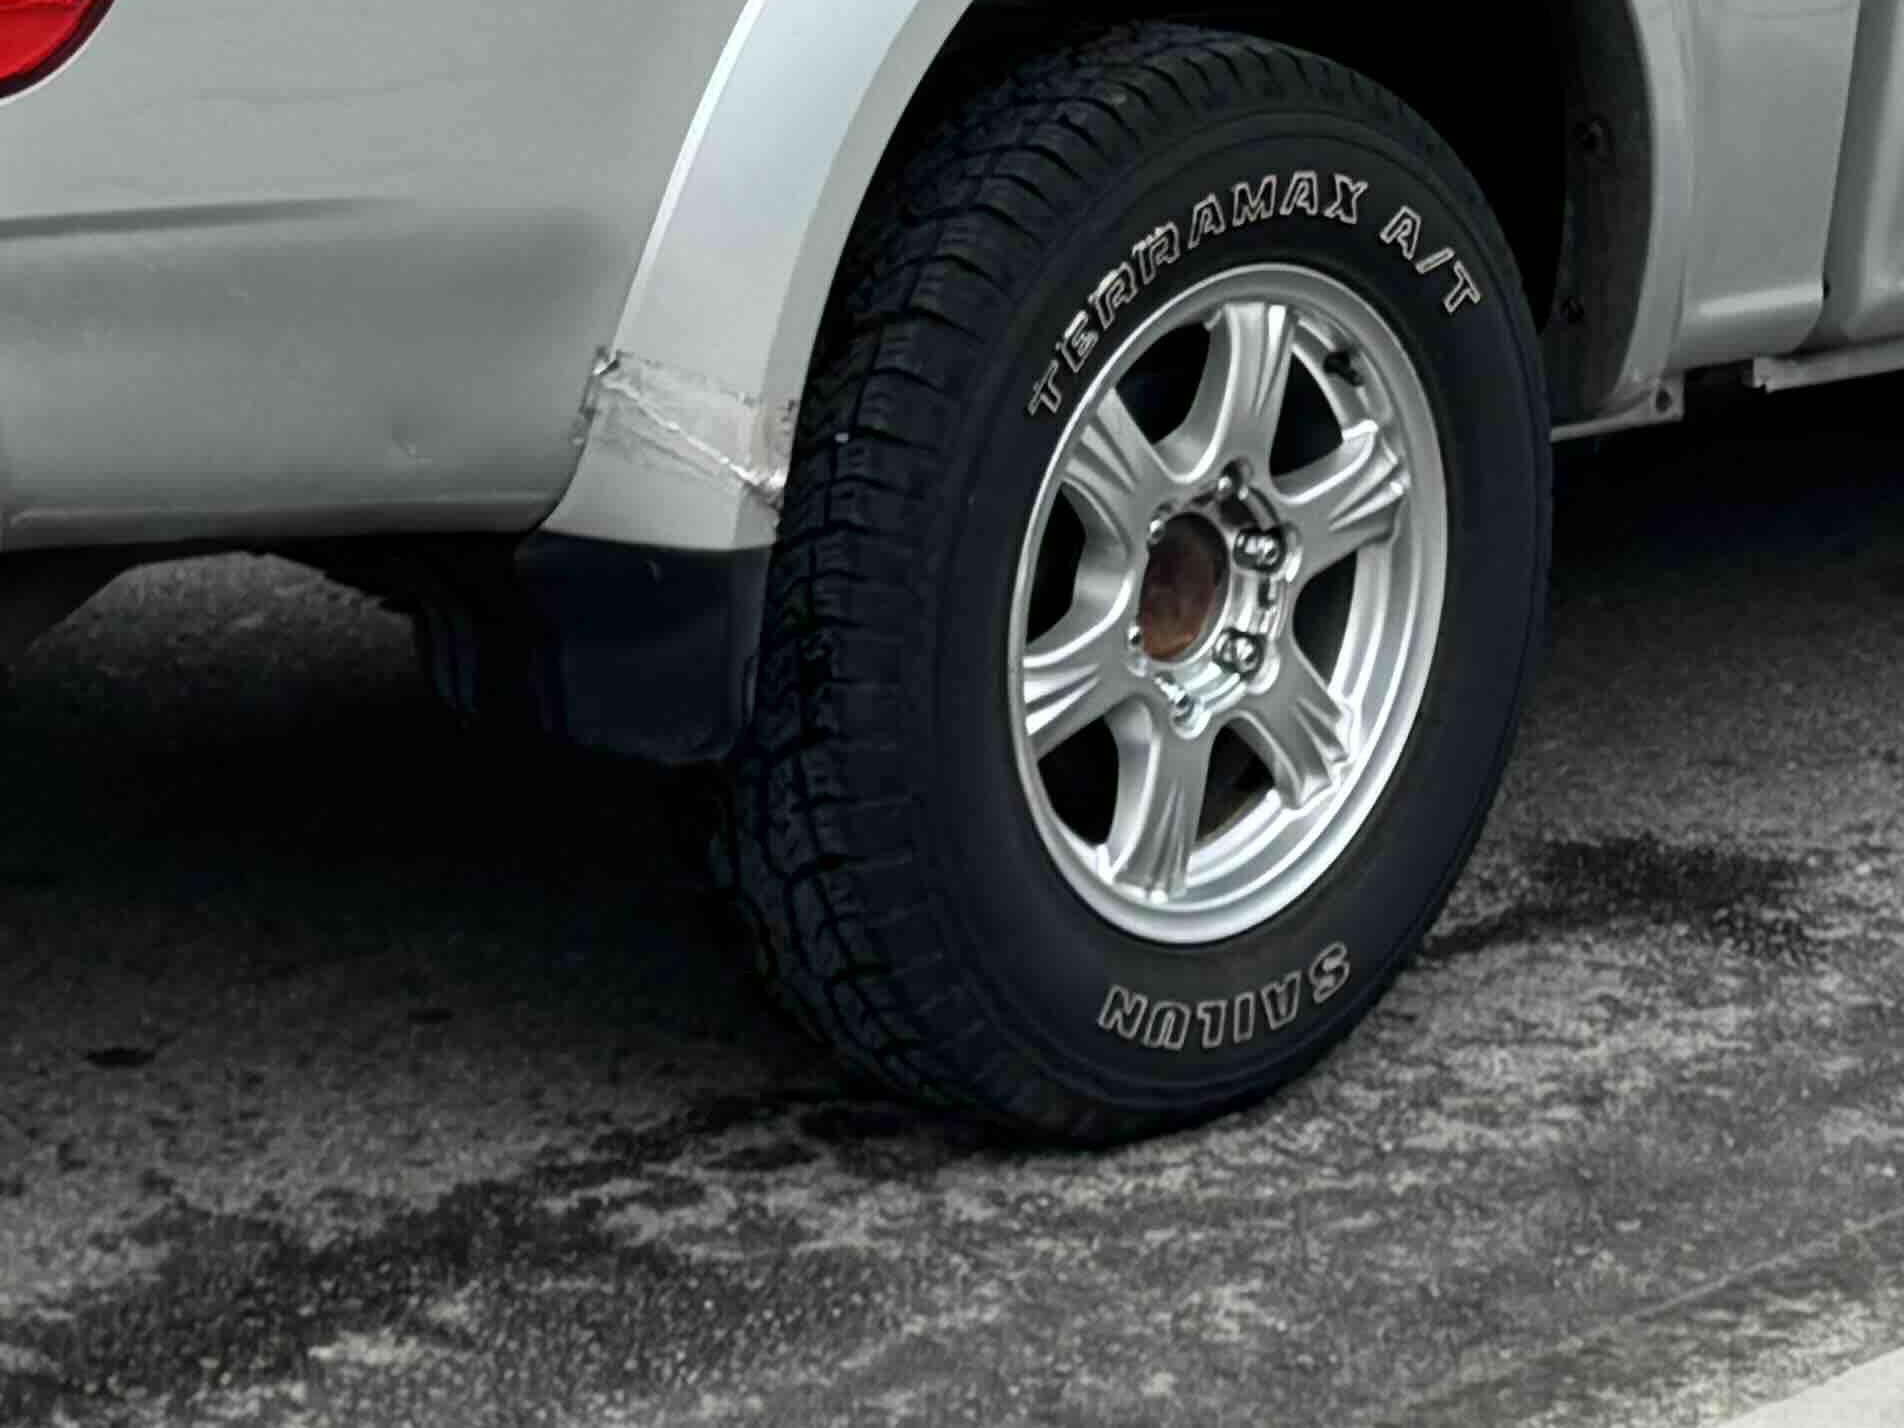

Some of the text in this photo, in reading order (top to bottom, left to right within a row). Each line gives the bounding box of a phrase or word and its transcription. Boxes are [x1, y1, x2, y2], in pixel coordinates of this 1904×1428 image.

[1027, 170, 1482, 417] TERRAMAX A/T
[1097, 941, 1351, 1051] SAILUN
